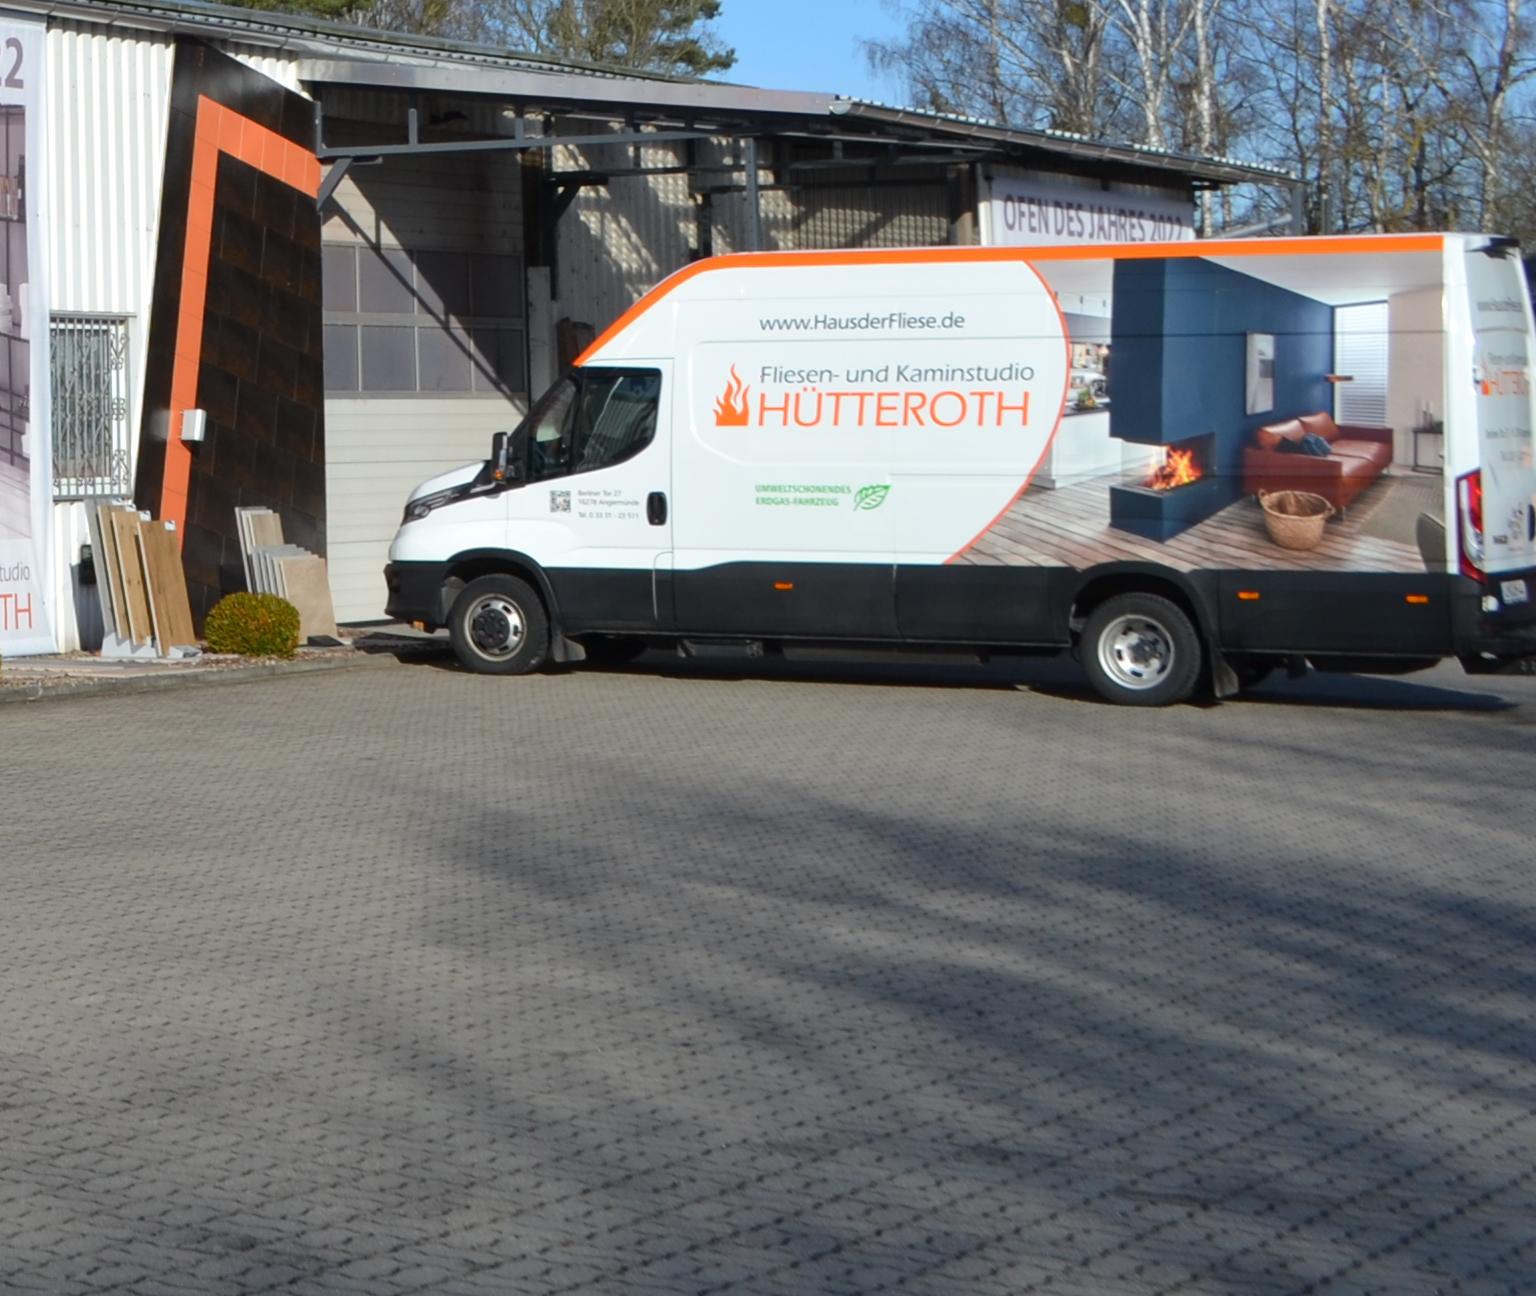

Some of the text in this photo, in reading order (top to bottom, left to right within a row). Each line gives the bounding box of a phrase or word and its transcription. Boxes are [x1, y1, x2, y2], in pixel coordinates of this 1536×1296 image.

[1003, 194, 1049, 236] OFEN
[1053, 203, 1085, 237] DES
[1089, 205, 1145, 242] JAHRES
[759, 311, 966, 331] www.HausderFliese.de
[760, 363, 1035, 384] Fliesen- und Kaminstudio
[758, 386, 1030, 427] HÜTTEROTH
